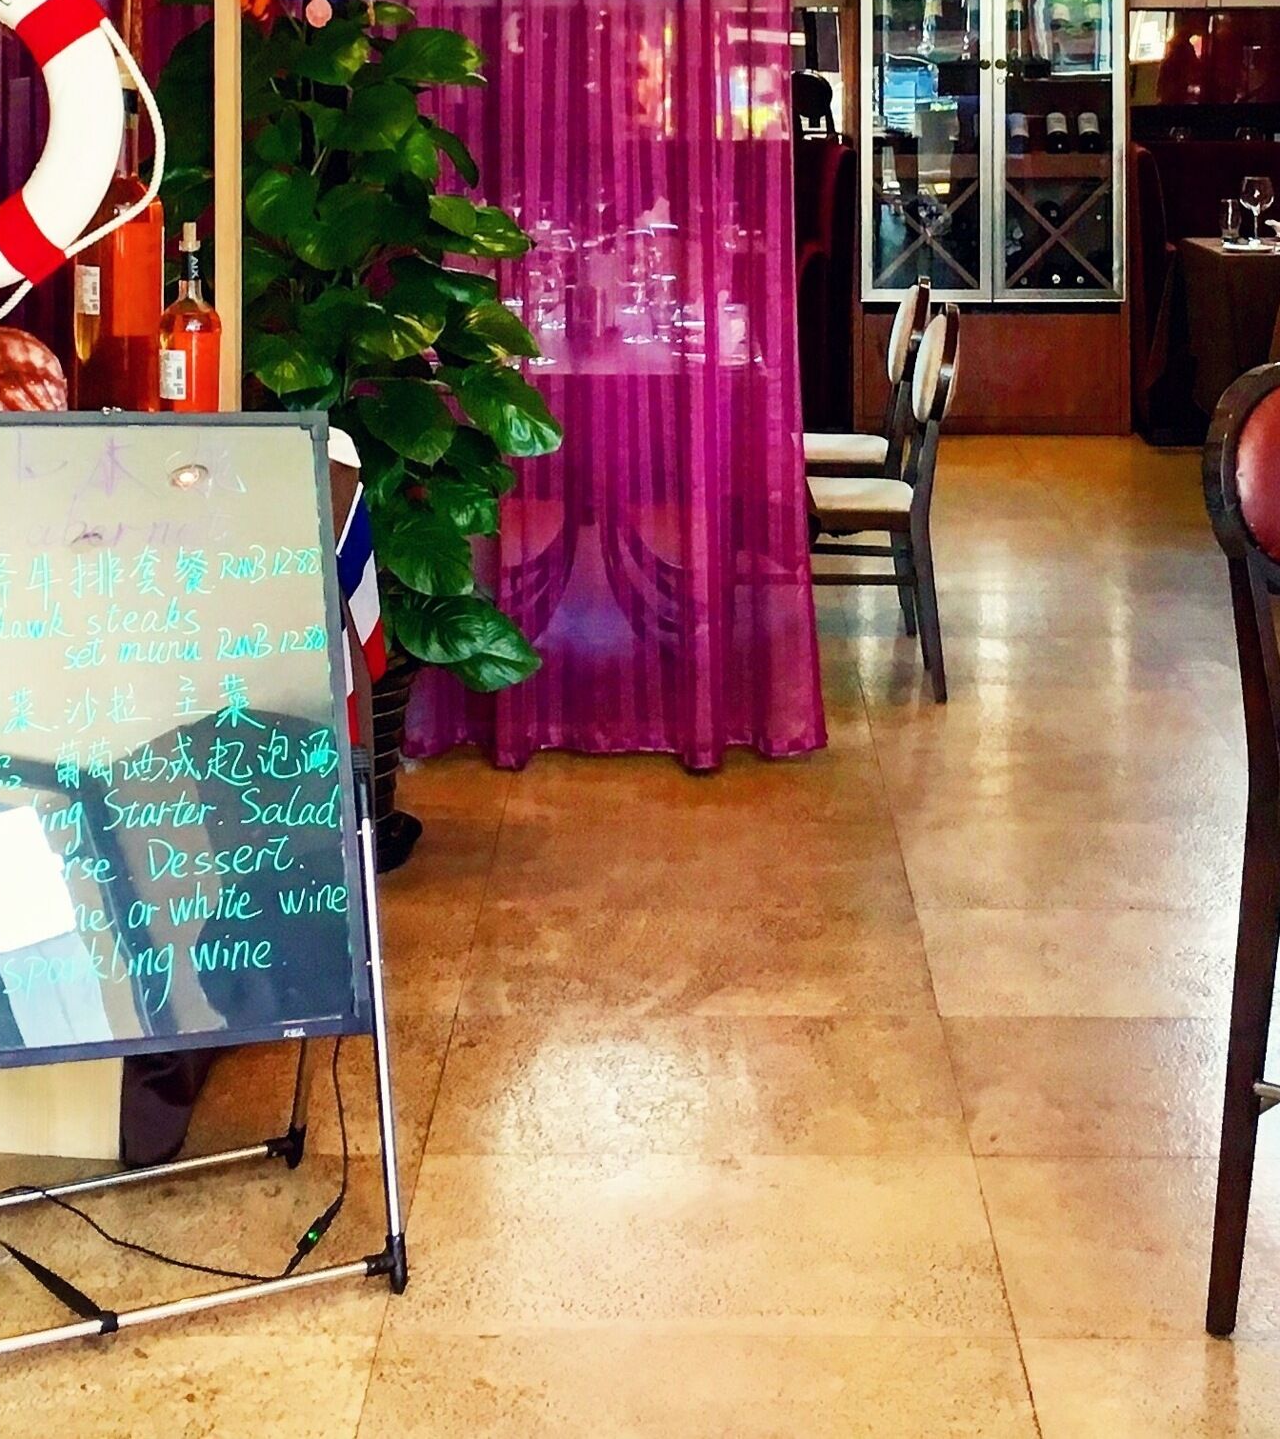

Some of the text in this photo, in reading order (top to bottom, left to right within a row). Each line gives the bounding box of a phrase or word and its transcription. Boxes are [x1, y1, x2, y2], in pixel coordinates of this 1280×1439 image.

[86, 596, 202, 635] steaks
[63, 638, 107, 670] set
[239, 785, 340, 830] Salad
[128, 898, 161, 924] or
[170, 883, 262, 927] white
[279, 880, 347, 913] wine
[3, 933, 174, 1014] sparkling
